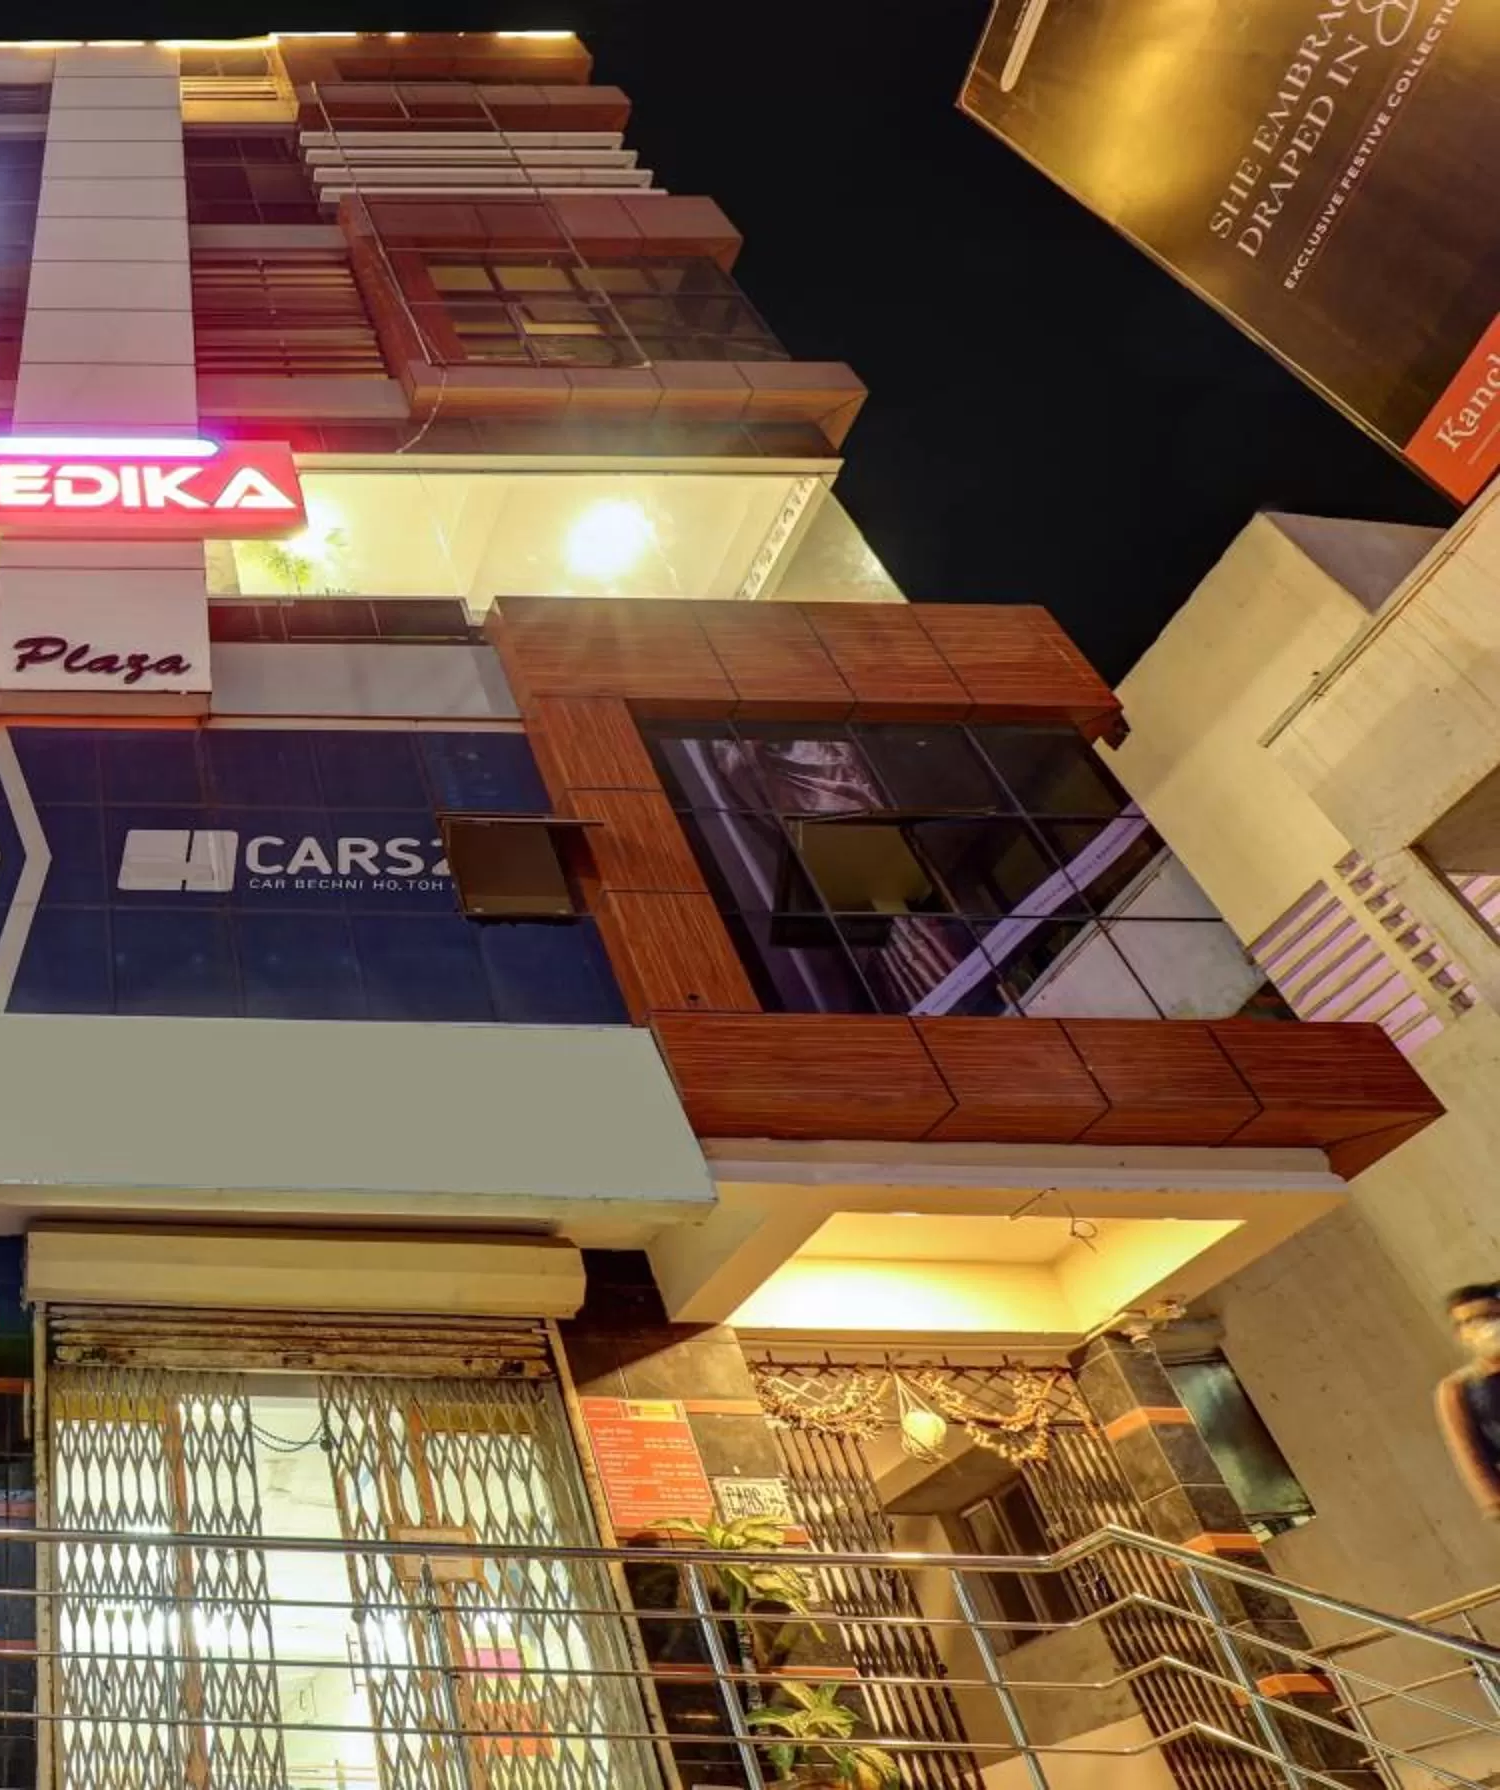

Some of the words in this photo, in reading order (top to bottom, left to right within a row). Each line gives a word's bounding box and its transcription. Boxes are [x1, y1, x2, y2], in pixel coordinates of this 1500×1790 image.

[1236, 95, 1335, 258] DRAPED
[1326, 33, 1370, 87] IN
[1209, 157, 1263, 239] SHE
[1283, 190, 1345, 290] EXCLUSIVE
[1340, 112, 1391, 190] FESTIVE
[12, 636, 193, 682] Plaza
[249, 879, 286, 890] CAR
[295, 879, 364, 890] BECHNI
